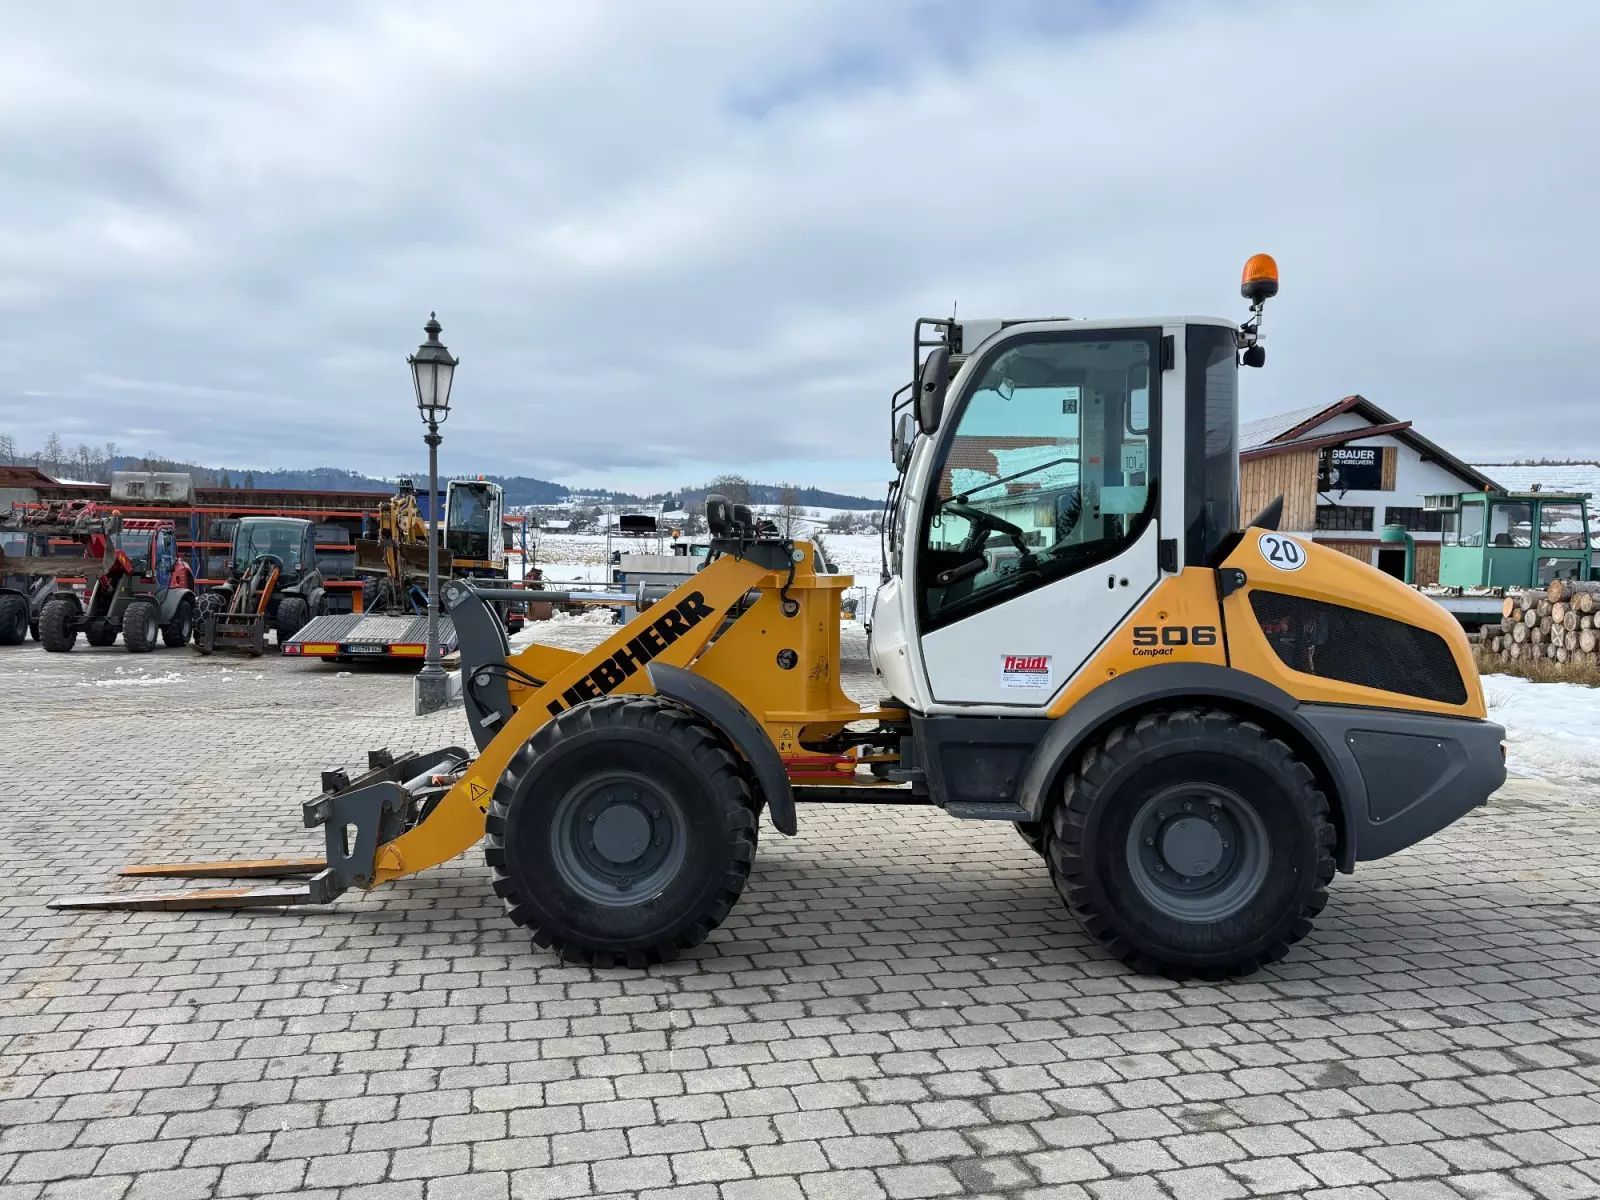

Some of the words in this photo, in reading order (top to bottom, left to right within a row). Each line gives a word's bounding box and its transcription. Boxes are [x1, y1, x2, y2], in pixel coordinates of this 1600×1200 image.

[1266, 537, 1298, 563] 20
[1133, 625, 1216, 646] 506
[1132, 647, 1174, 657] Compact
